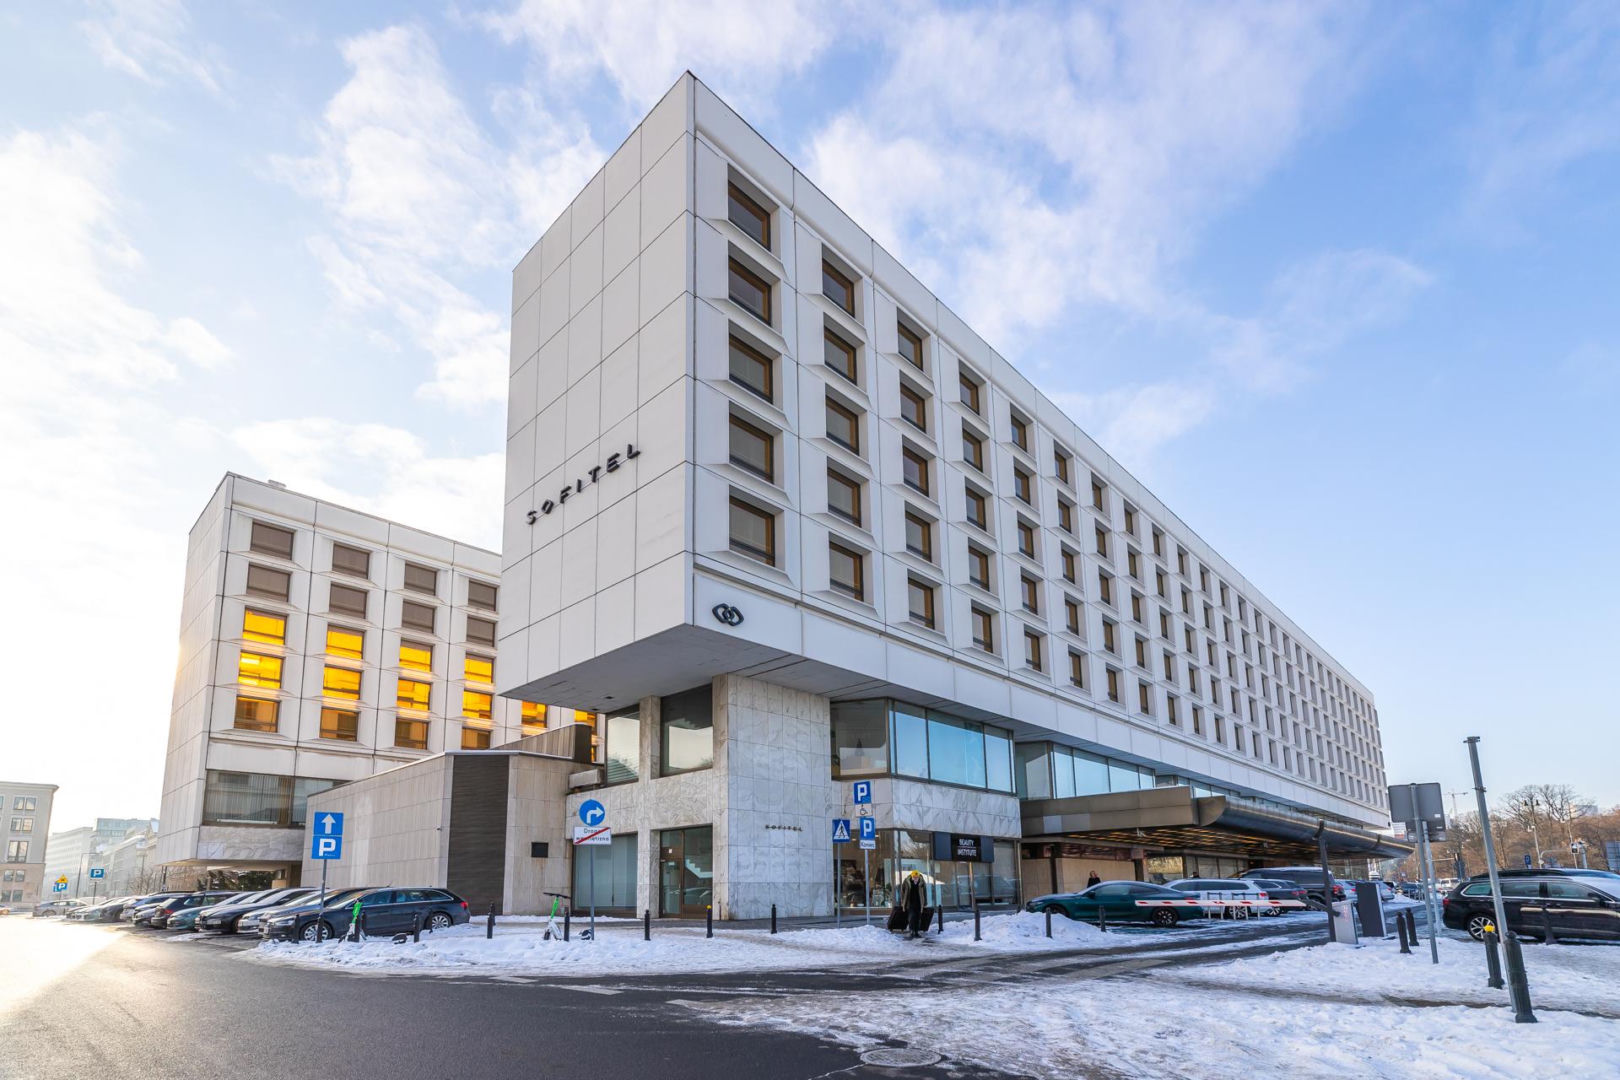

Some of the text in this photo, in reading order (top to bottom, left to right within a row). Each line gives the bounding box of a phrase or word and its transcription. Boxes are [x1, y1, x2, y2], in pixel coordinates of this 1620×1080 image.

[526, 444, 641, 525] SOFITEL
[857, 784, 867, 802] P
[765, 824, 803, 832] SOFITEL
[864, 819, 872, 837] P
[319, 838, 336, 857] P
[959, 838, 975, 846] BEAUTY
[957, 849, 977, 857] INSTITUTE
